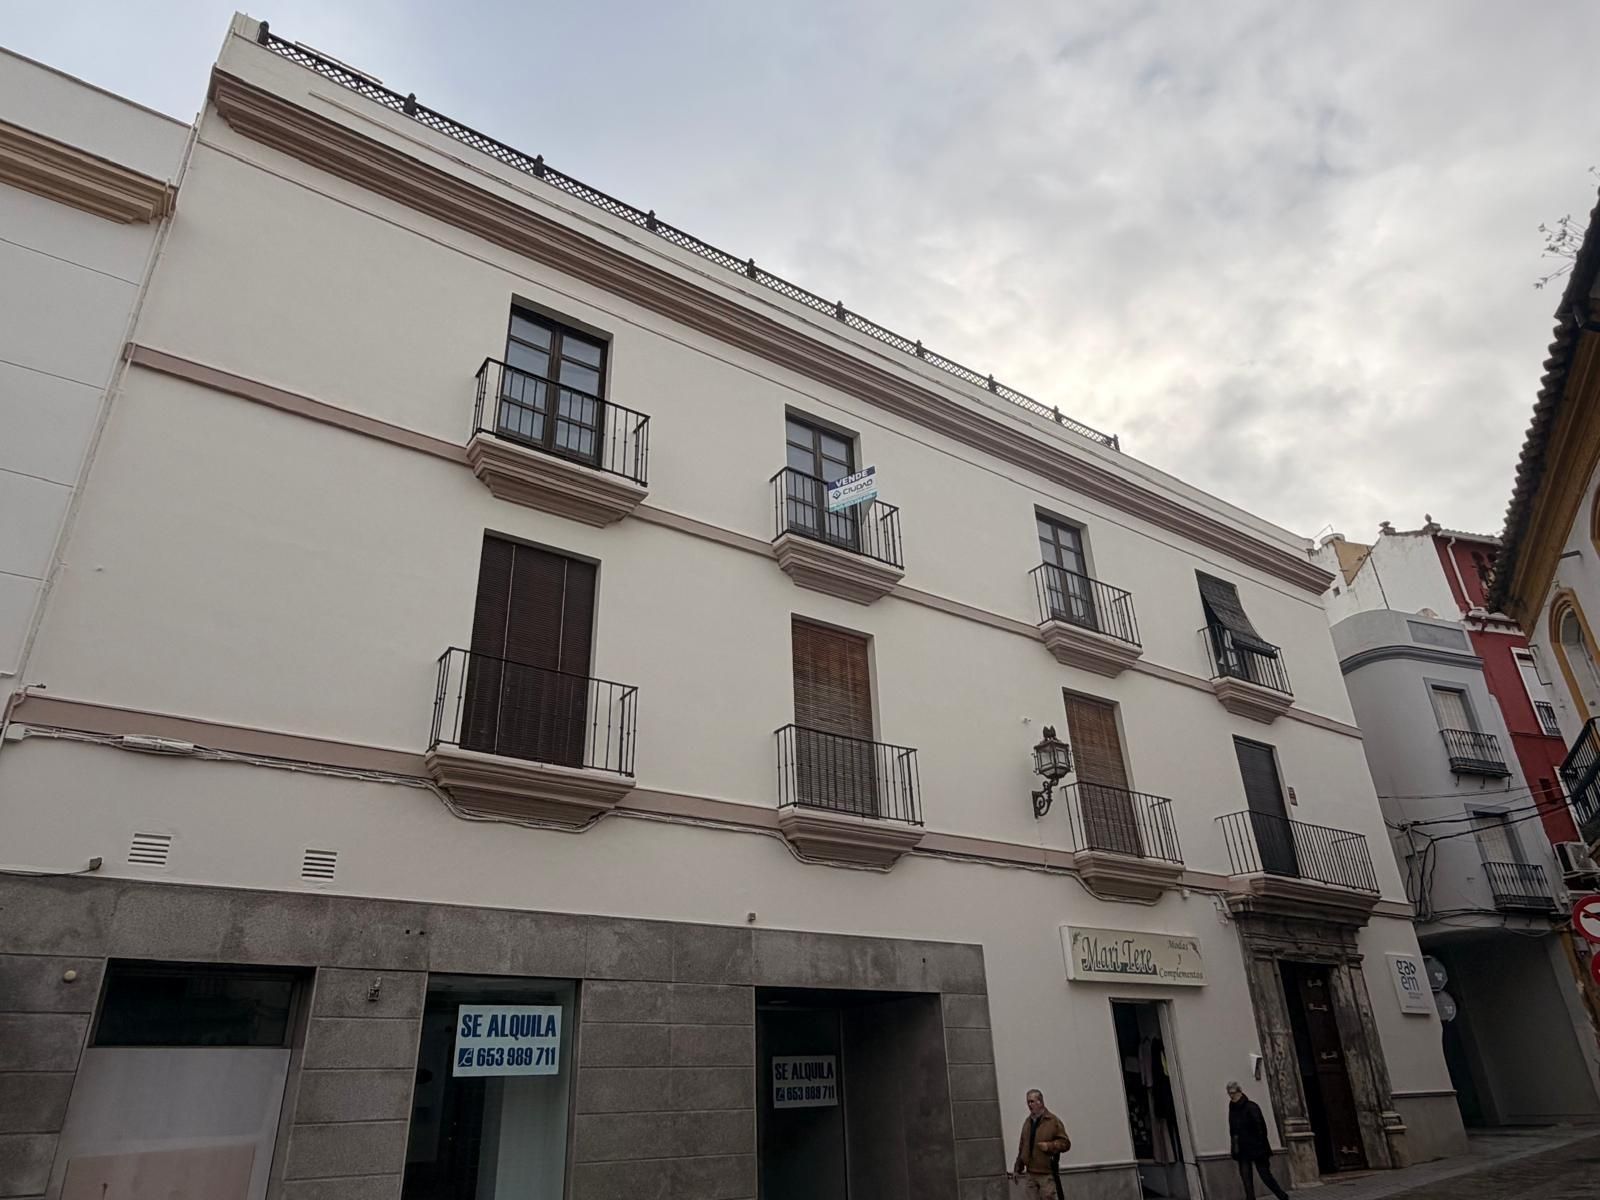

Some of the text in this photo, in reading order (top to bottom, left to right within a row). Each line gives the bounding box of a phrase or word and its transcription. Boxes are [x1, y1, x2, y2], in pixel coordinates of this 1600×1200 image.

[835, 470, 868, 487] VENDE
[843, 479, 873, 495] CIUDAD
[1082, 936, 1154, 973] Mari Tere
[461, 1014, 556, 1041] SE ALQUILA
[476, 1047, 556, 1066] 653 989 711
[774, 1061, 834, 1081] SE ALQUILA
[822, 1085, 835, 1099] 711
